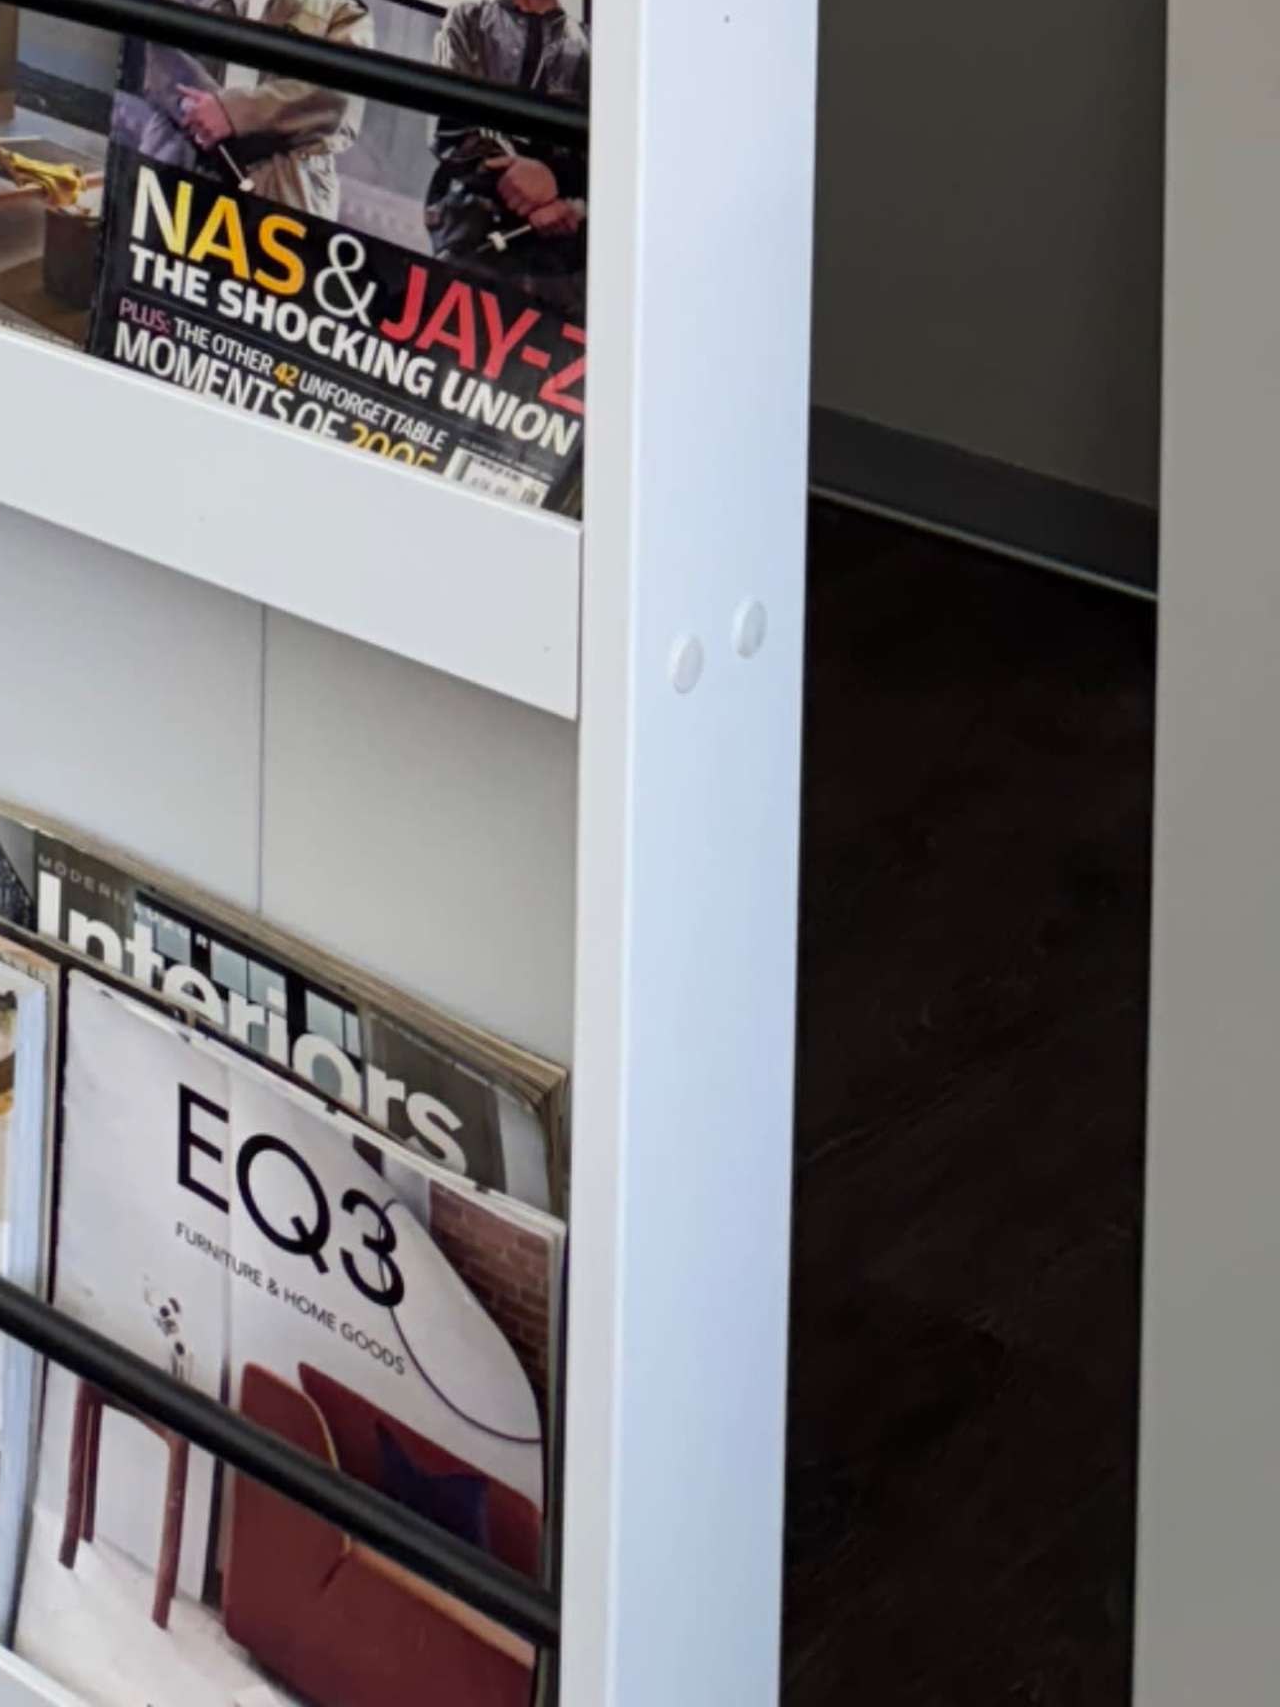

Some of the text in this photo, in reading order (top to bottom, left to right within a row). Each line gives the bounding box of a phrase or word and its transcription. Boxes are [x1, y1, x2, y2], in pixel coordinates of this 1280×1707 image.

[131, 164, 307, 295] NAS
[313, 234, 376, 328] &
[113, 321, 295, 424] MOMENTS
[118, 296, 170, 333] PLUS:
[172, 317, 209, 347] THE
[212, 333, 273, 377] OTHER
[274, 361, 298, 387] 42
[299, 372, 448, 450] UNFORGETTABLE
[128, 243, 581, 458] THE SHOCKING UNION
[38, 853, 128, 907] MODERN
[37, 871, 468, 1190] Interiors
[177, 1082, 405, 1308] EQ3
[175, 1220, 406, 1377] FURNITURE & HOME GOODS
